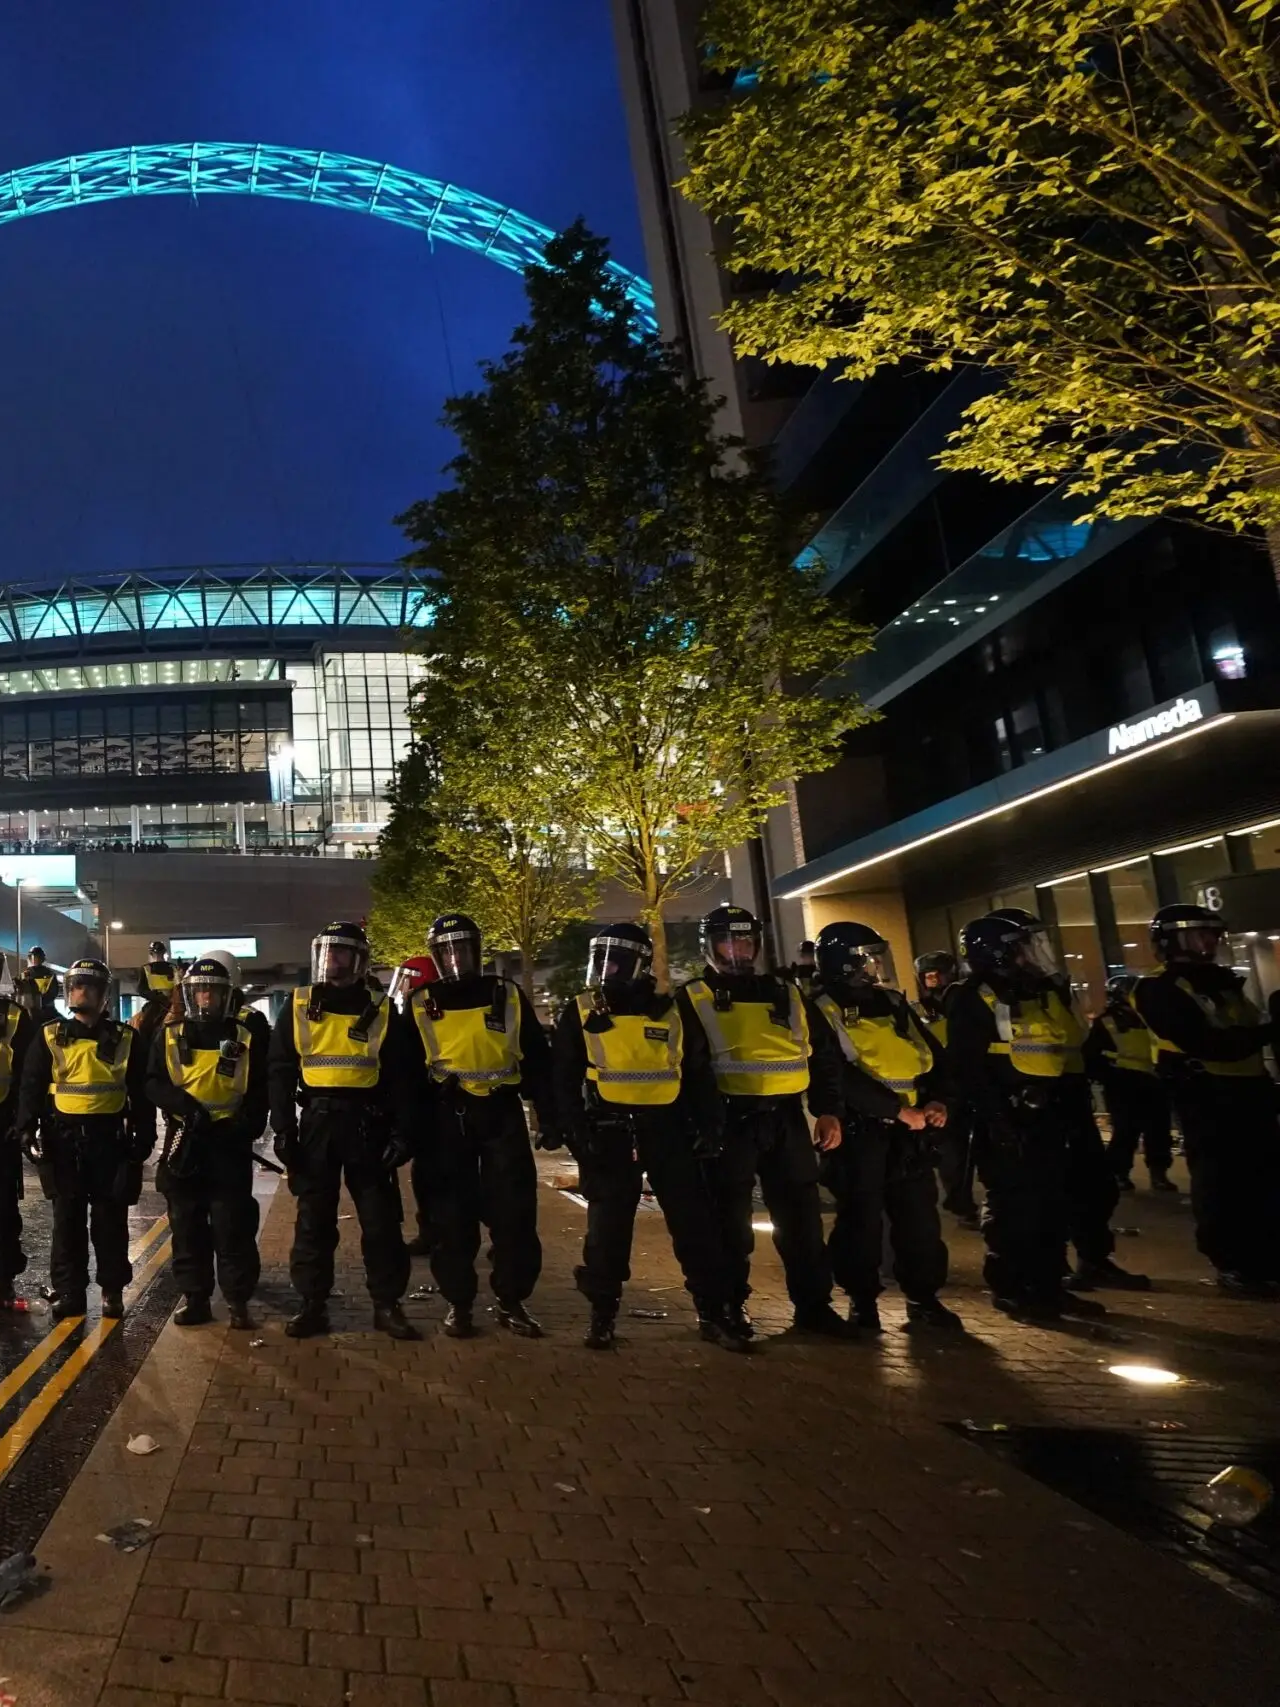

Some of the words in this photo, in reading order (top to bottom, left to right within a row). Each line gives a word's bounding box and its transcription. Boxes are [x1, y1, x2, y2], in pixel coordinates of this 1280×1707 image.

[1108, 698, 1203, 755] Alameda
[1196, 886, 1224, 911] 48
[443, 919, 458, 928] MP
